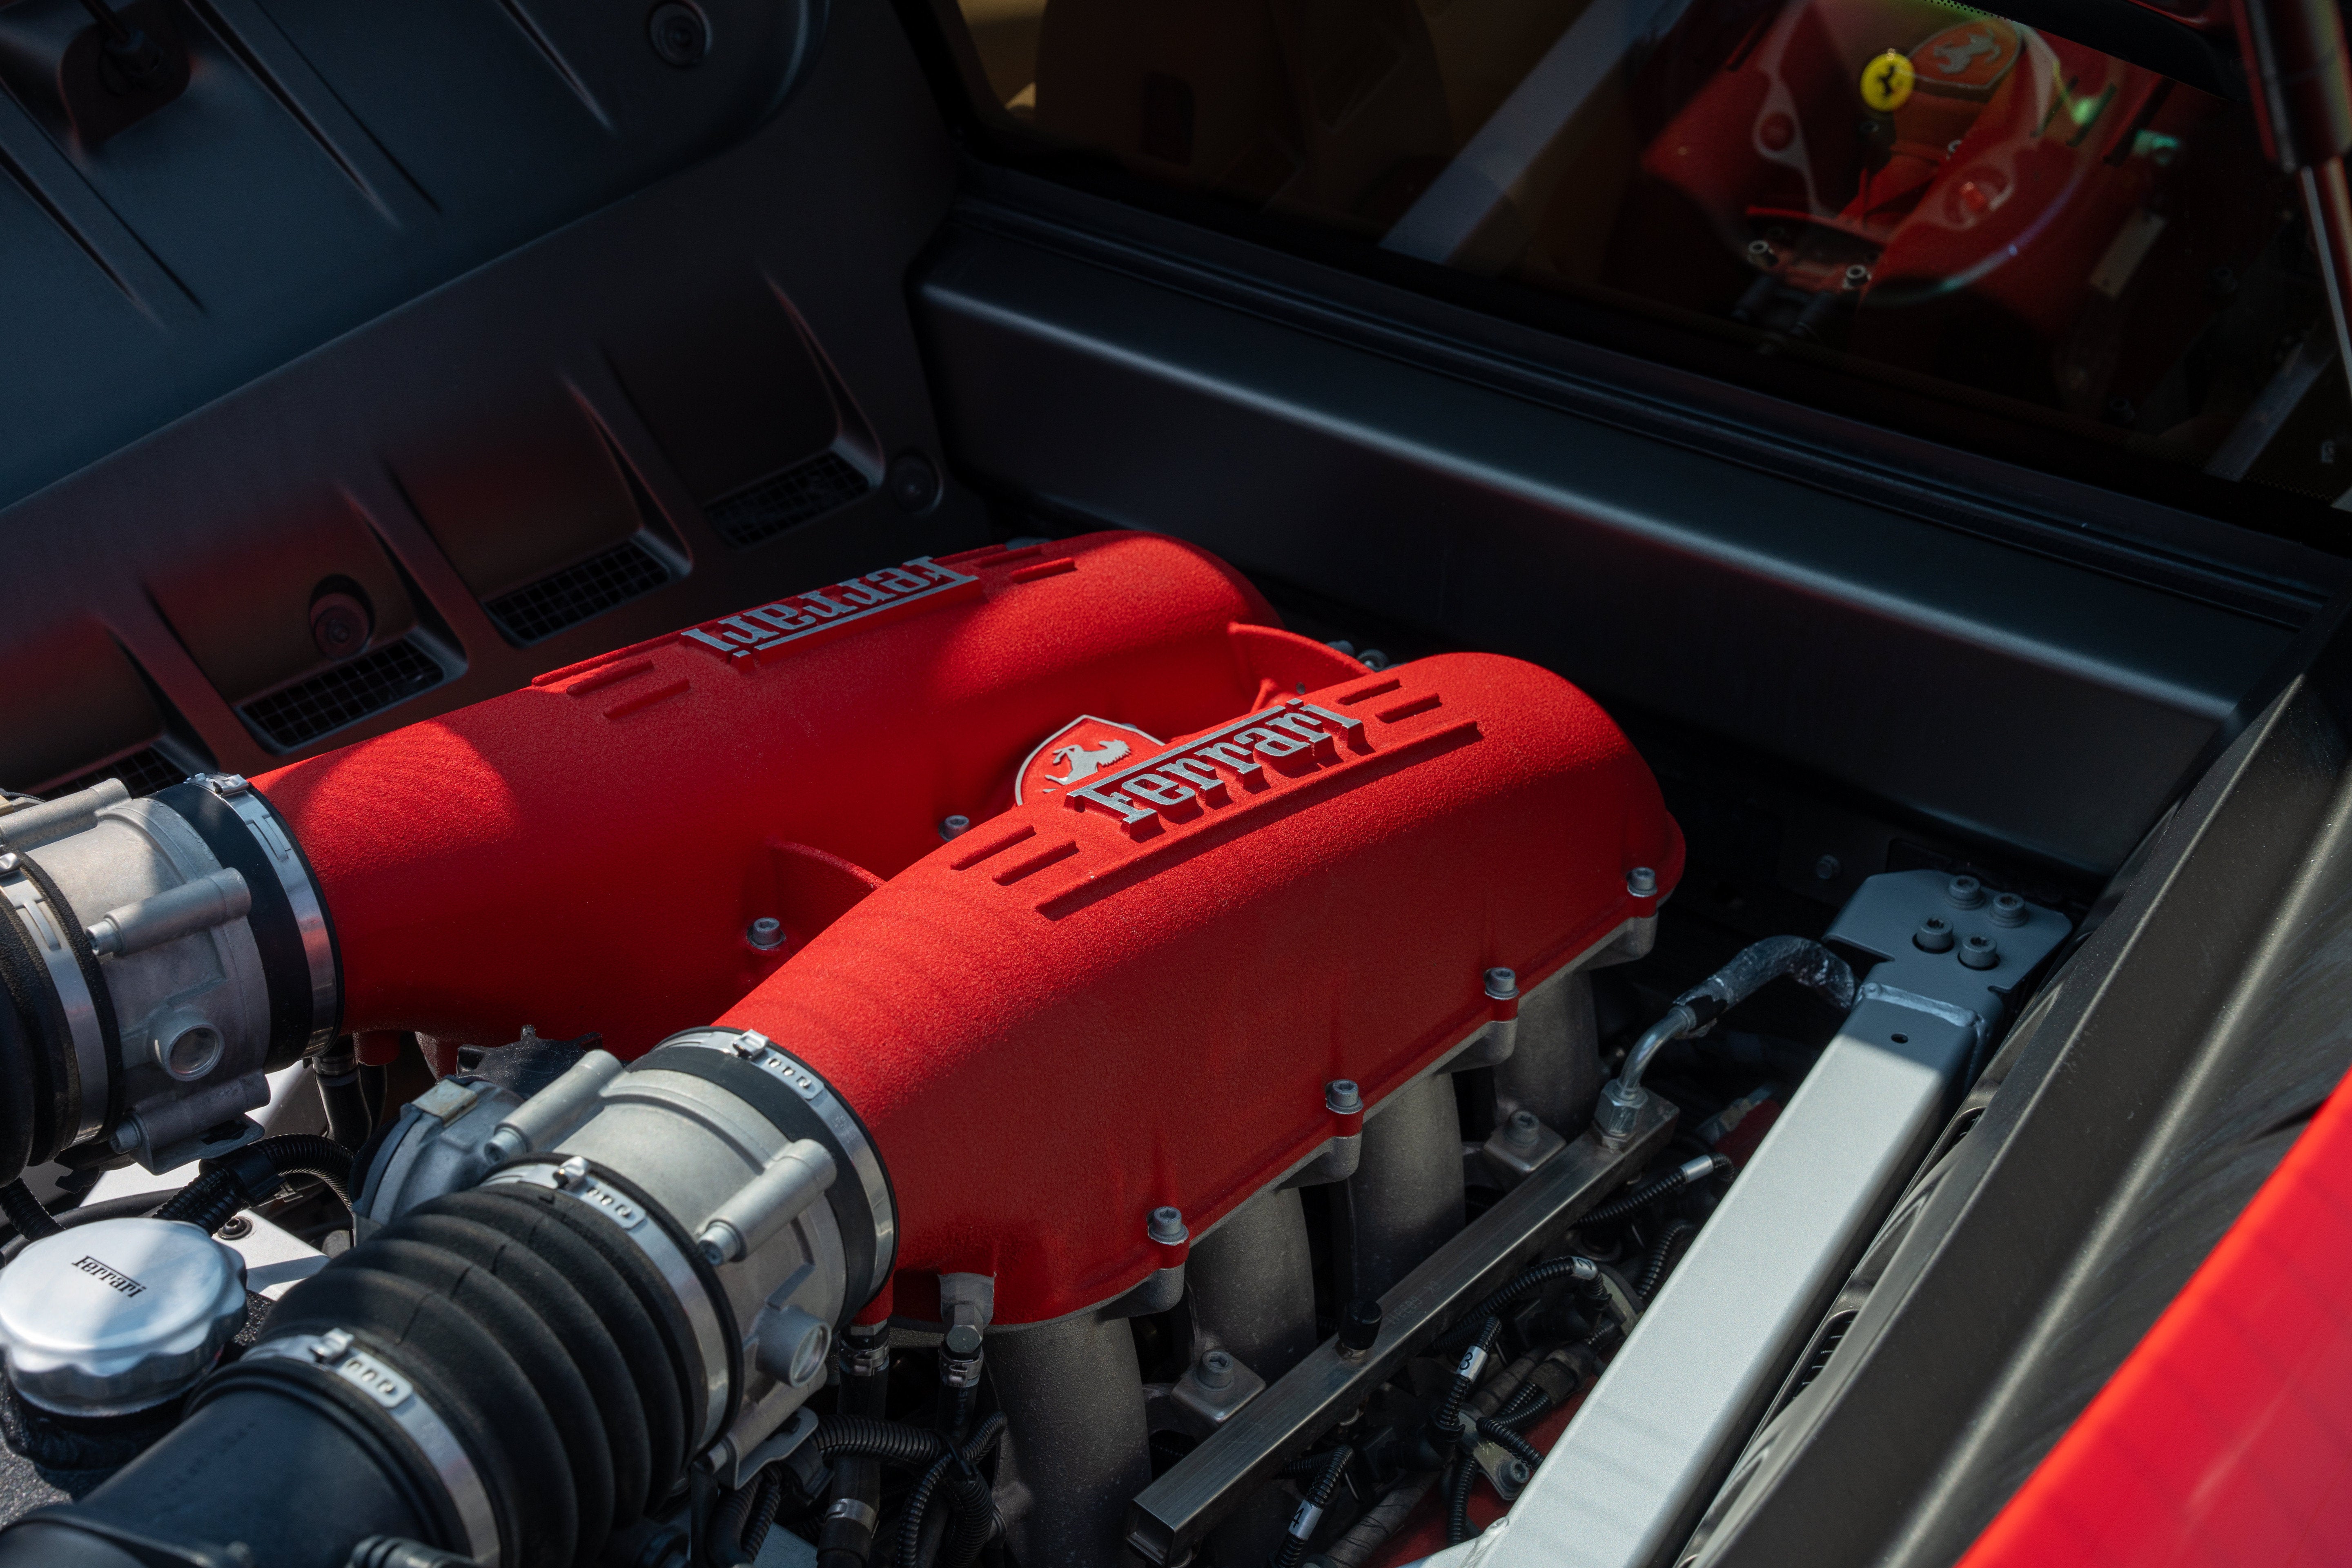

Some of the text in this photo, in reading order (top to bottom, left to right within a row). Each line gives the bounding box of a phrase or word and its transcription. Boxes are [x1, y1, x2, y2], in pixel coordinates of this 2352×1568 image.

[681, 555, 980, 657] Ferrari
[1066, 697, 1362, 824] Ferrari
[71, 1255, 147, 1298] Ferrari
[1577, 1258, 1592, 1270] 2
[1459, 1352, 1473, 1370] 3
[1292, 1508, 1304, 1528] 4
